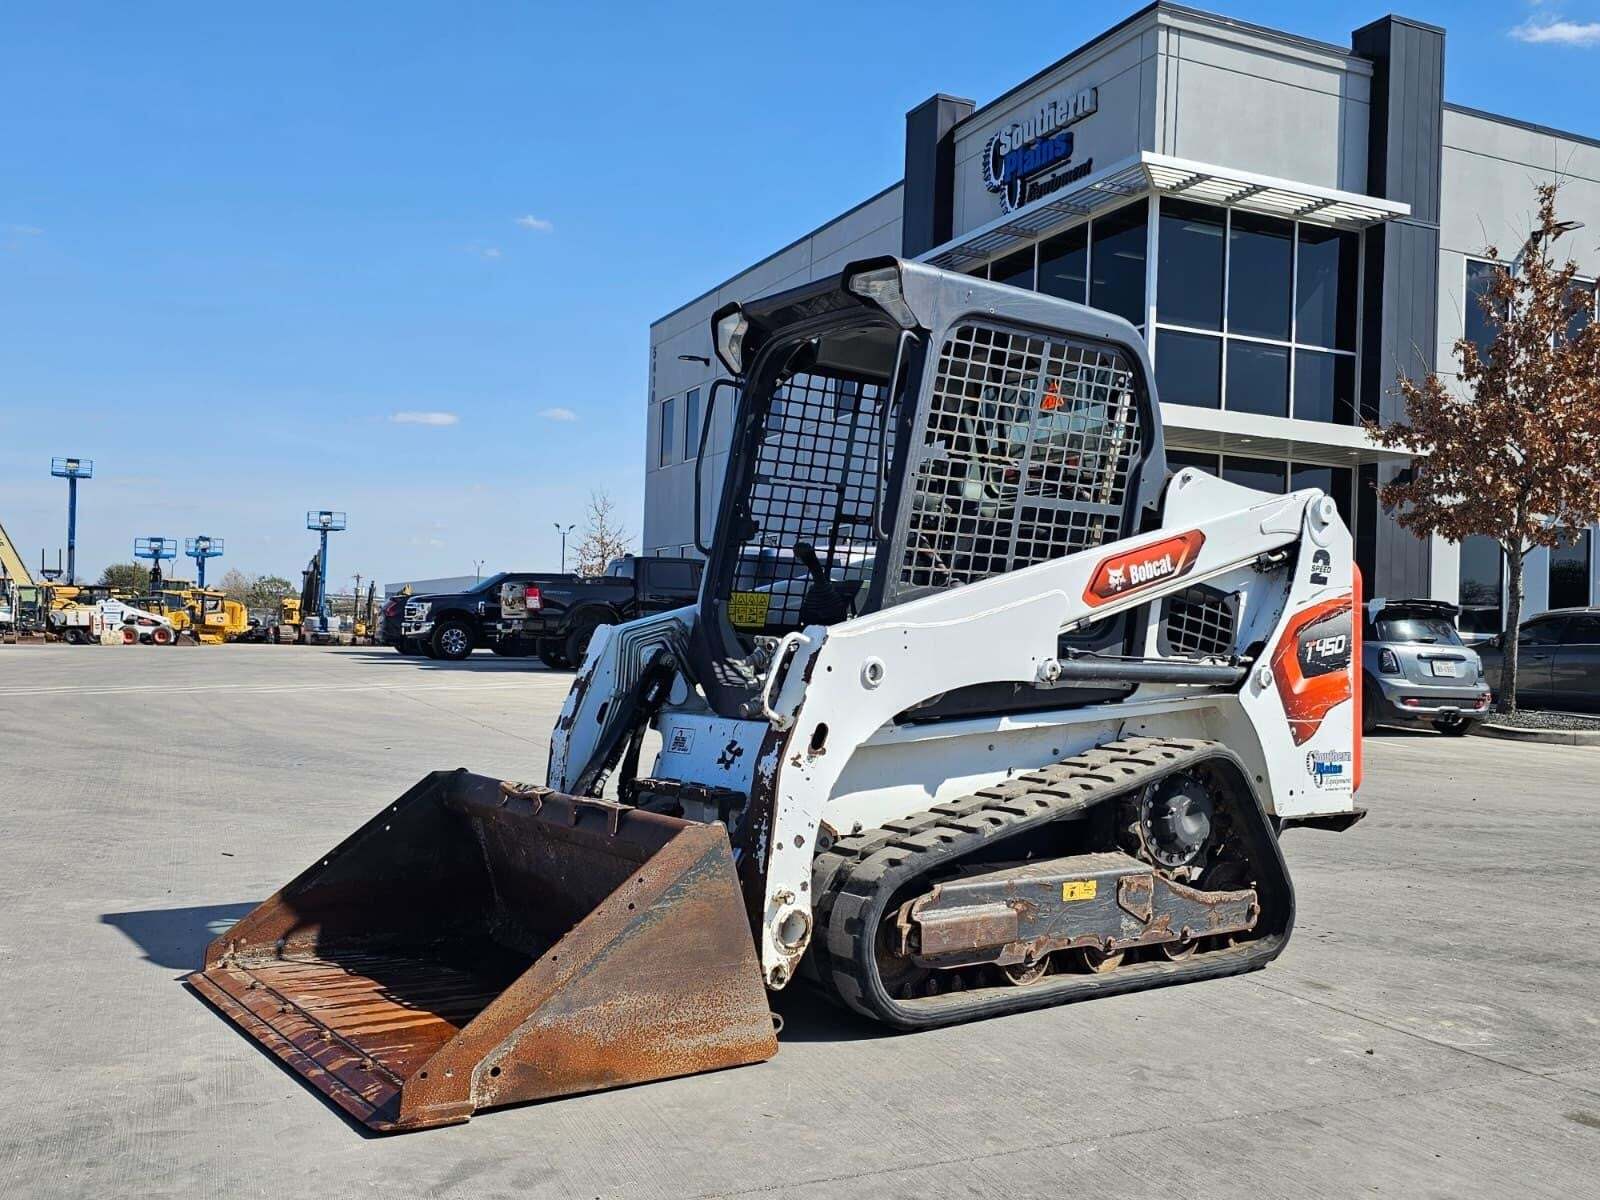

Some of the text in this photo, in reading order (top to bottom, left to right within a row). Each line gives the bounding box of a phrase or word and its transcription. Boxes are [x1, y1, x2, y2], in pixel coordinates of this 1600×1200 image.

[999, 87, 1098, 157] Southern
[1129, 553, 1174, 585] Bobcat
[1311, 565, 1332, 574] SPEED
[1305, 634, 1346, 663] T450
